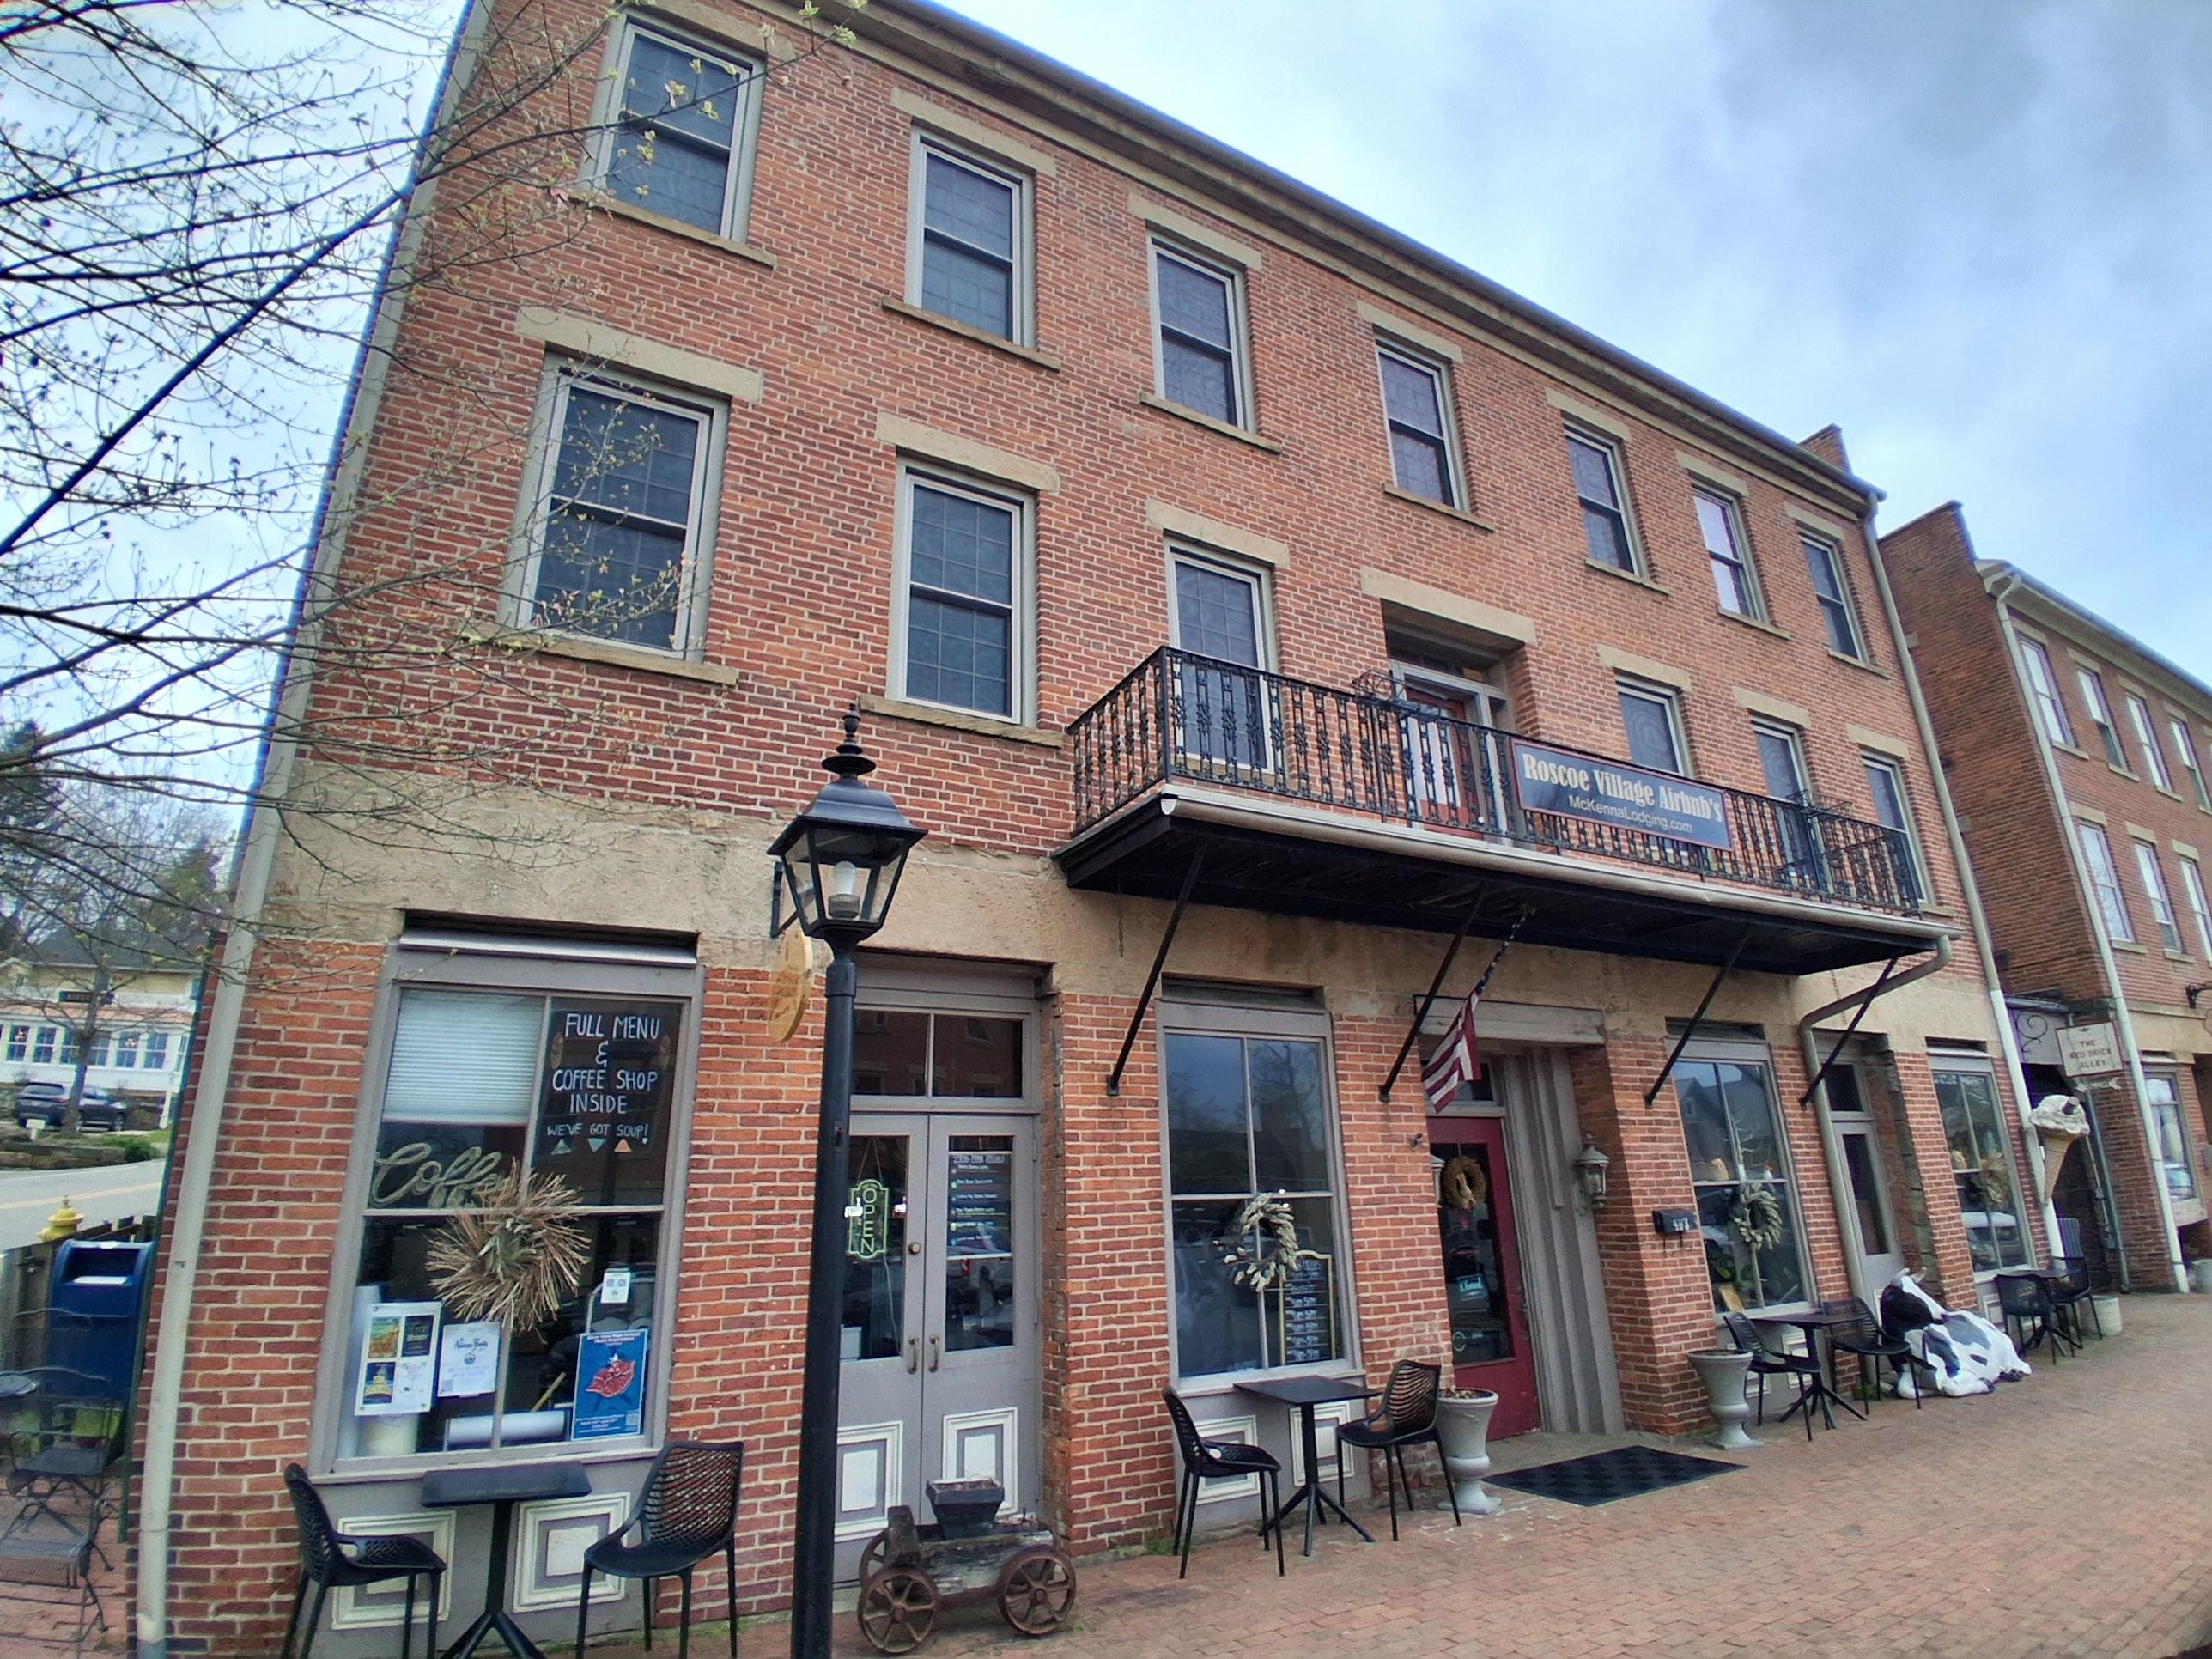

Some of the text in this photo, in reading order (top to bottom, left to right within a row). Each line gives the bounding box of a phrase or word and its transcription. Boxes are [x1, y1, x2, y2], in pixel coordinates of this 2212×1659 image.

[1522, 753, 1723, 823] Roscoe Village Airbnb's
[1568, 794, 1693, 834] McKennaLodging.com
[565, 1013, 660, 1039] FULL MENU
[2080, 1060, 2106, 1068] ALLEY
[552, 1069, 658, 1091] COFFEE SHOP
[570, 1093, 627, 1115] INSIDE
[589, 1123, 611, 1136] GOT
[616, 1122, 649, 1145] SOUP!
[860, 1188, 877, 1254] OPEN
